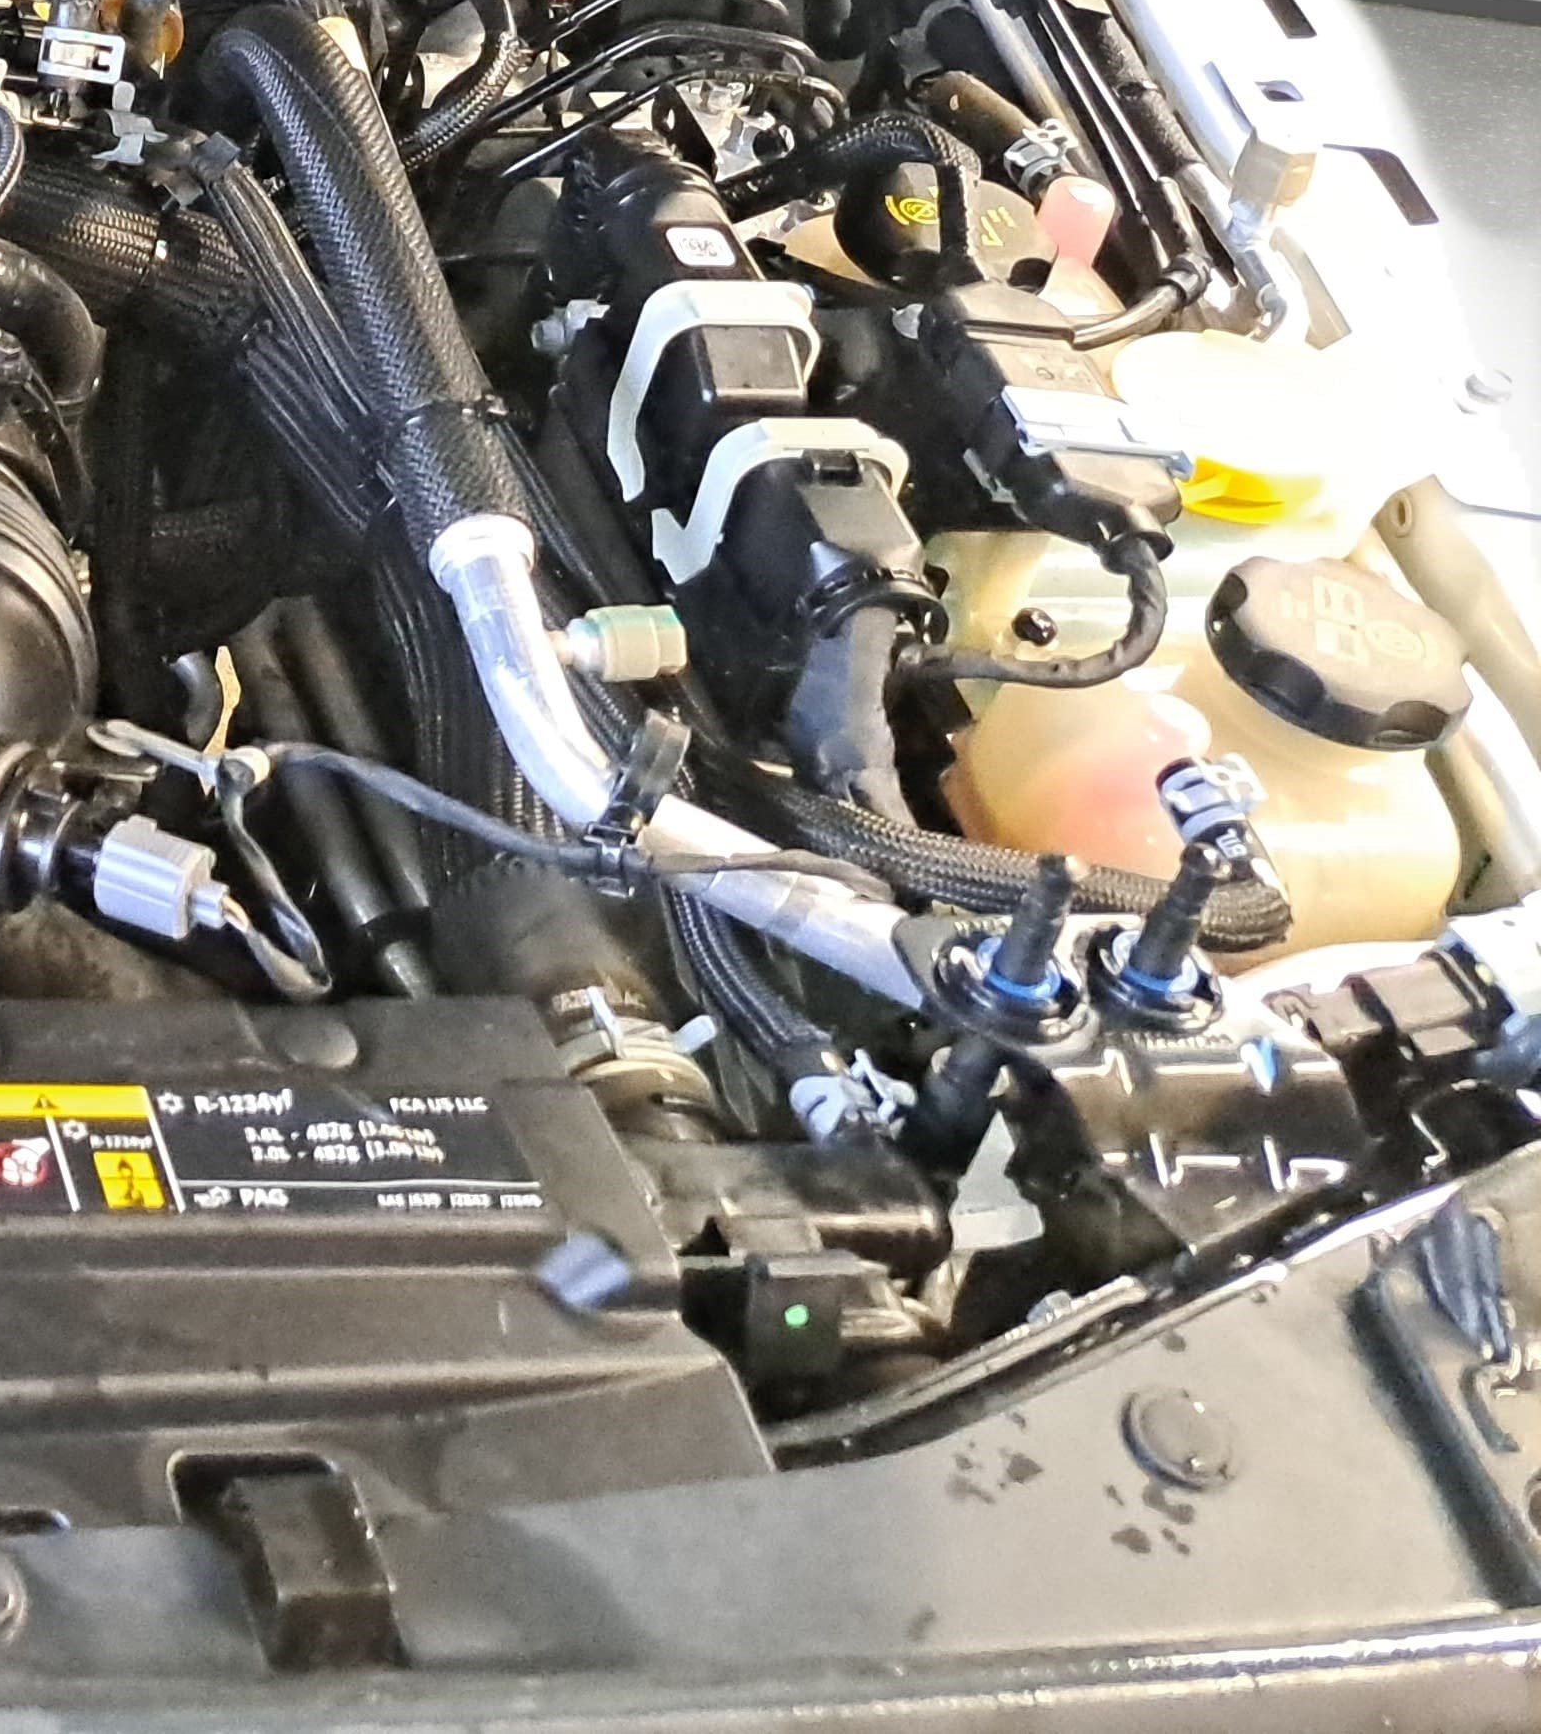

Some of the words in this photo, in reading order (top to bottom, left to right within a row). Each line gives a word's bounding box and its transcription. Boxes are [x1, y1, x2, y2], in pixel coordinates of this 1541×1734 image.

[389, 1096, 426, 1114] FCA
[426, 1096, 455, 1114] US
[455, 1096, 489, 1113] LLC
[239, 1187, 289, 1207] PAG
